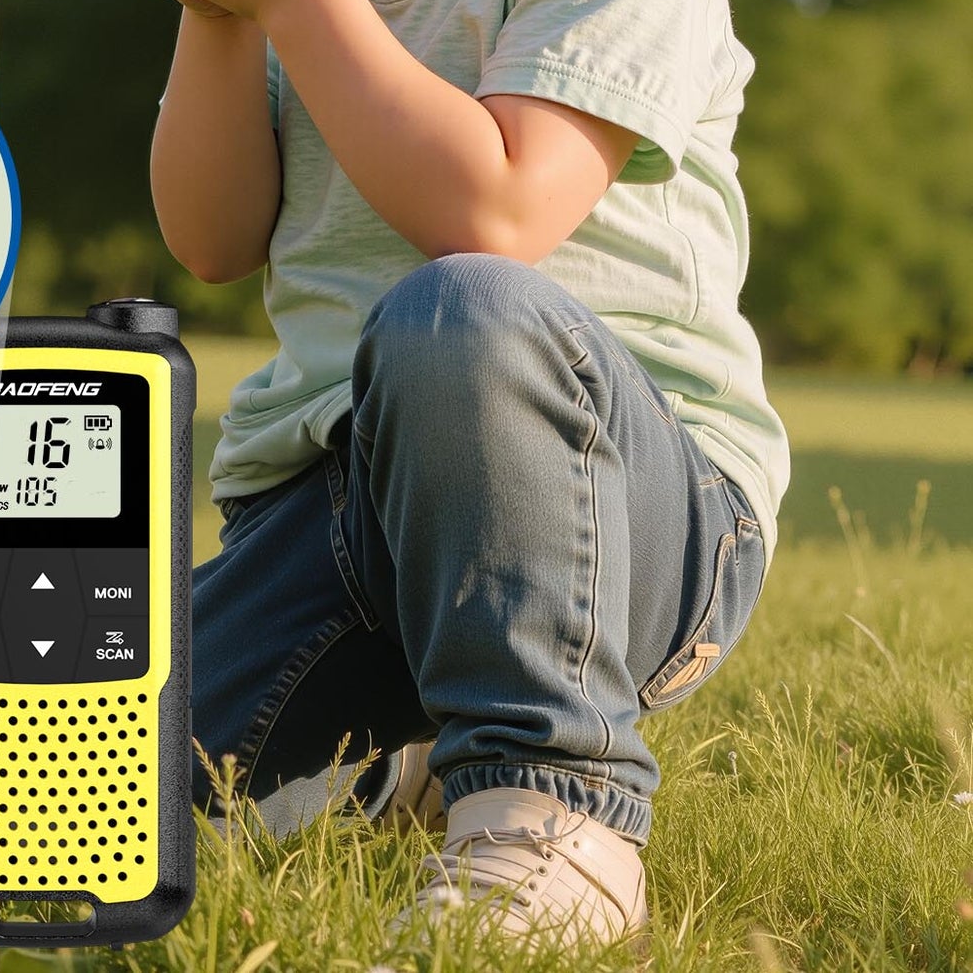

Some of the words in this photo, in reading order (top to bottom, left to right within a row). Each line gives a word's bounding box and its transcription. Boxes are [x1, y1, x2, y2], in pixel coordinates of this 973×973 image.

[27, 417, 71, 469] 16
[16, 477, 57, 506] 105
[94, 588, 132, 599] MONI
[95, 648, 134, 660] SCAN
